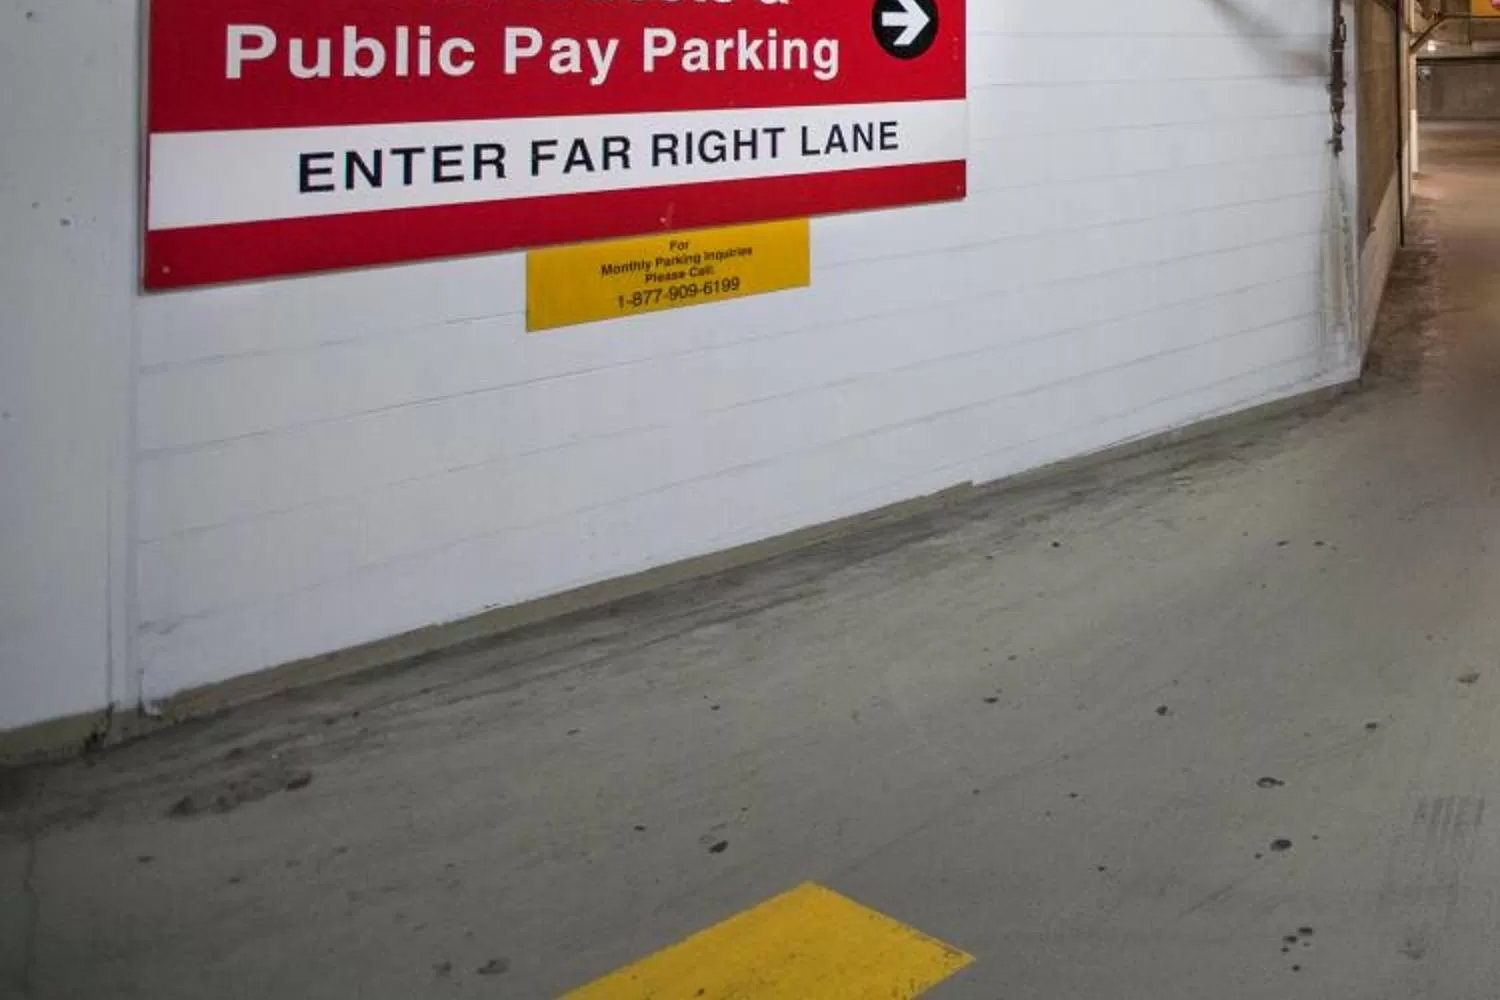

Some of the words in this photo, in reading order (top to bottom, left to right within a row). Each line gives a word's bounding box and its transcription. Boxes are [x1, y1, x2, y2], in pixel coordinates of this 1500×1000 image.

[225, 23, 475, 79] Public
[503, 26, 620, 86] Pay
[642, 26, 840, 82] Parking
[299, 143, 506, 194] ENTER
[530, 135, 631, 177] FAR
[651, 127, 786, 167] RIGHT
[800, 120, 899, 157] LANE
[669, 239, 689, 251] For
[601, 258, 652, 276] Monthly
[655, 252, 701, 268] Parking
[703, 246, 753, 263] Inquiries
[617, 276, 741, 309] 1-877-909-6199
[644, 270, 685, 284] Please
